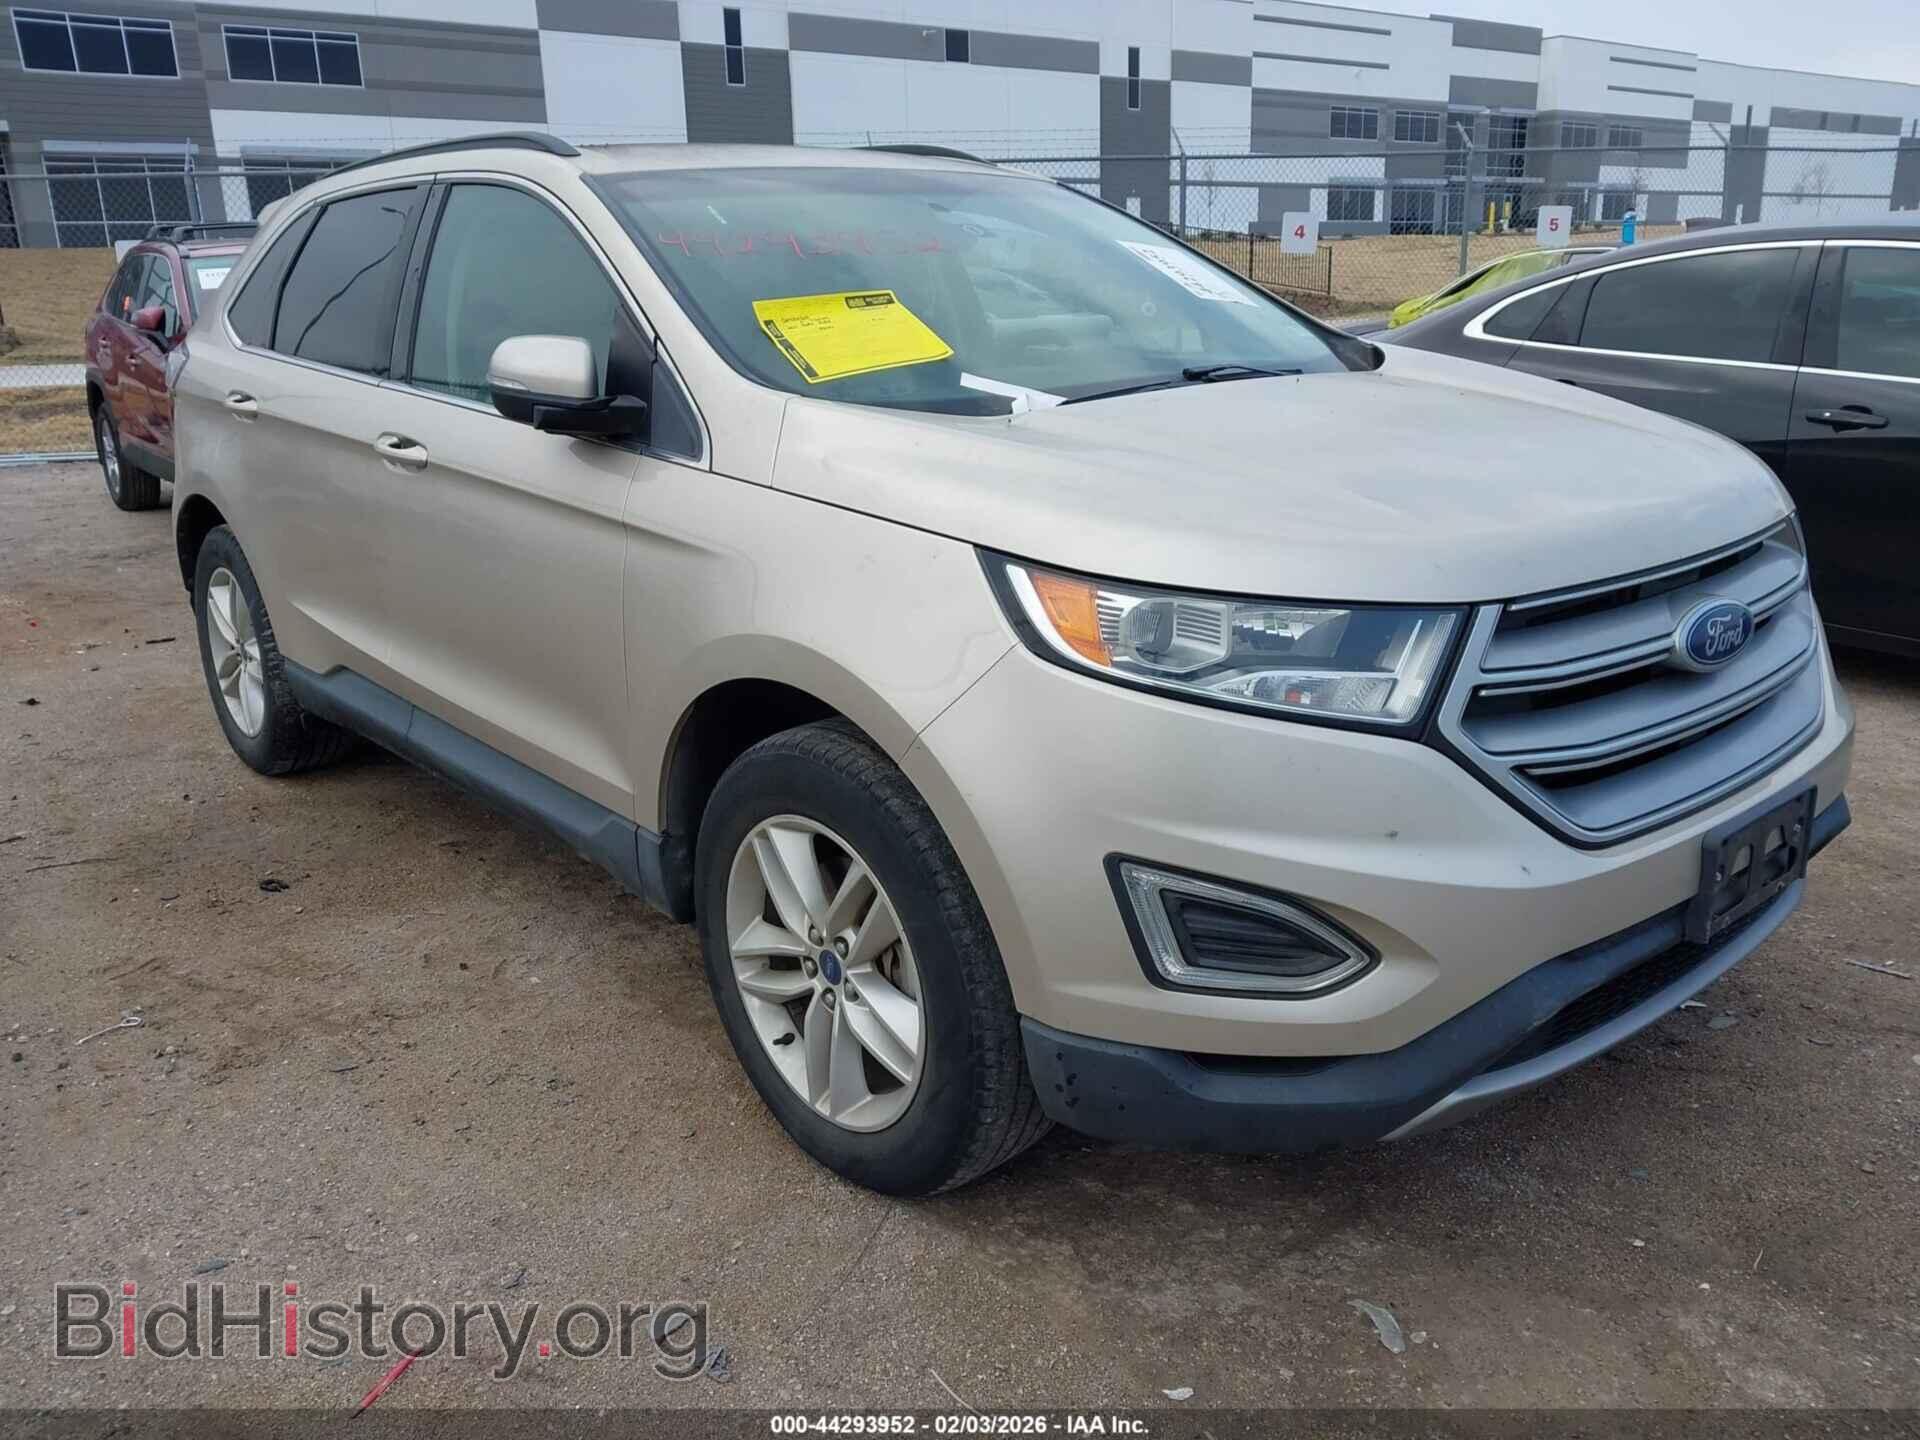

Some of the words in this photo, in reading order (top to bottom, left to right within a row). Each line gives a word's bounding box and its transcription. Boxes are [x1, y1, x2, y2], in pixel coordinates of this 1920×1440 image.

[1294, 224, 1305, 239] 4
[1550, 217, 1559, 232] 5
[1705, 613, 1744, 656] Ford
